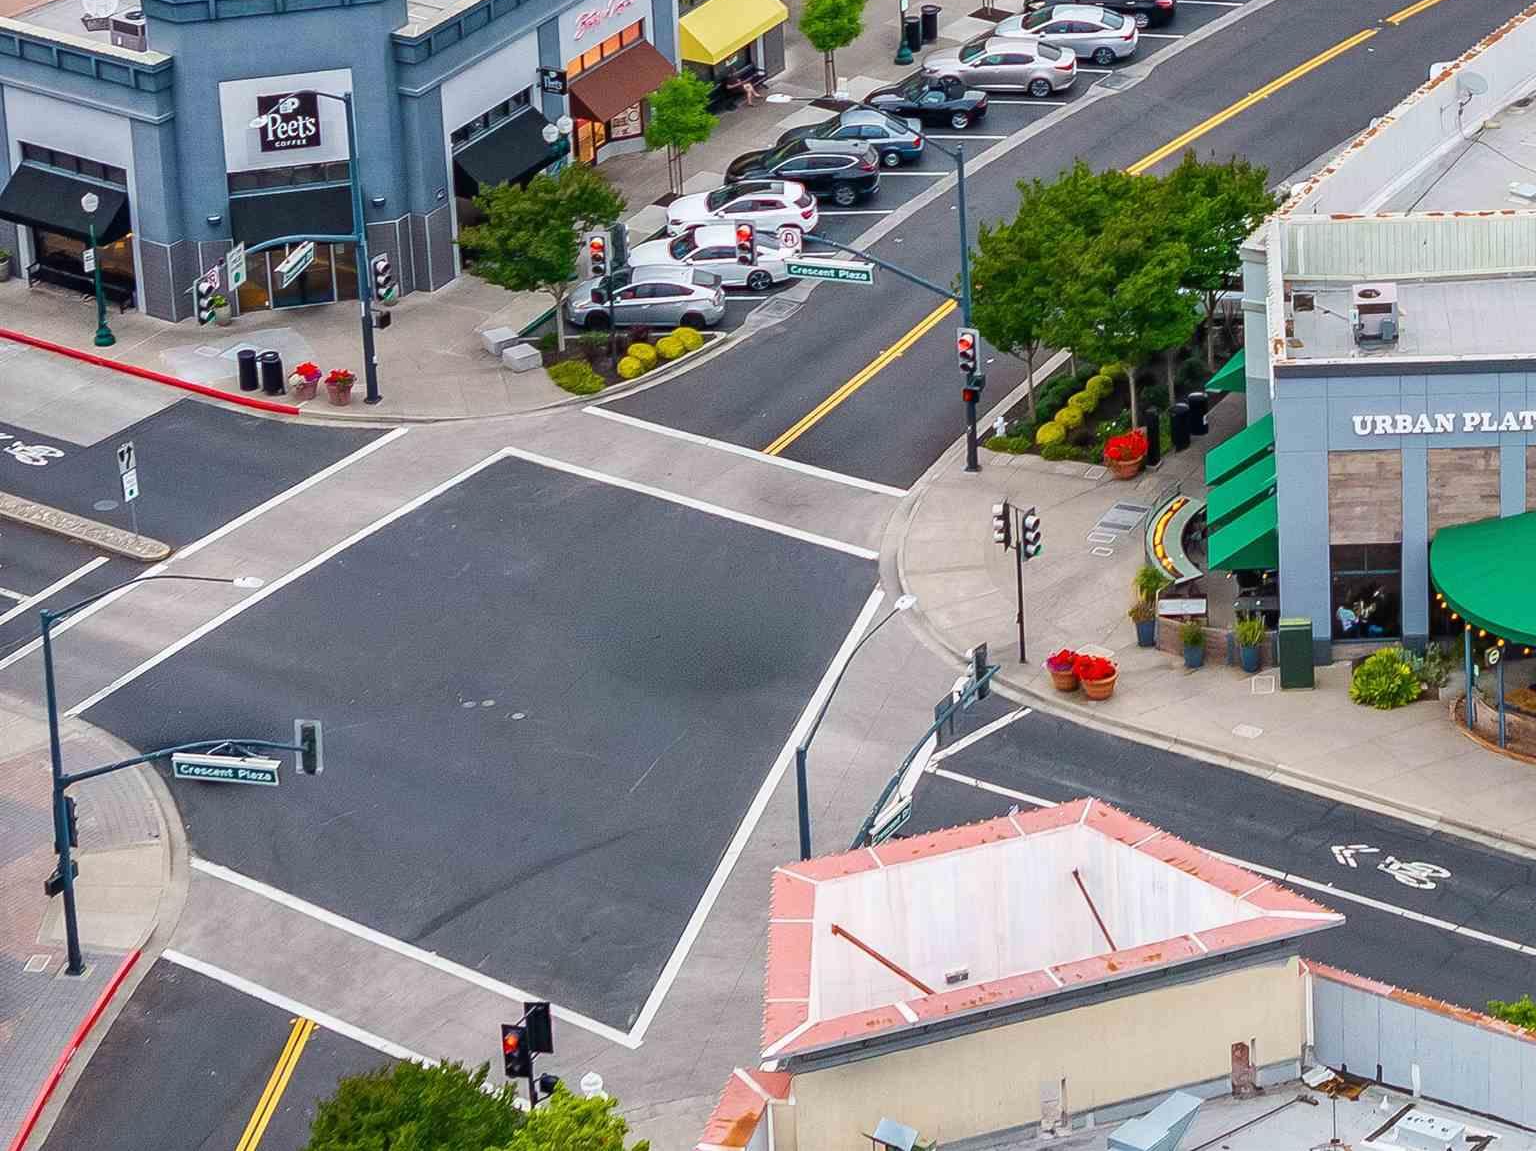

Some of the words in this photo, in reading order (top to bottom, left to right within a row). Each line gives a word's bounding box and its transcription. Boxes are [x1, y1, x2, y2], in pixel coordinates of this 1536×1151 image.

[266, 113, 316, 141] Peet's
[790, 265, 835, 278] Crescent
[838, 269, 867, 280] Plaza
[1352, 412, 1456, 436] URBAN
[180, 764, 234, 777] Crescent
[238, 769, 272, 781] Plaza
